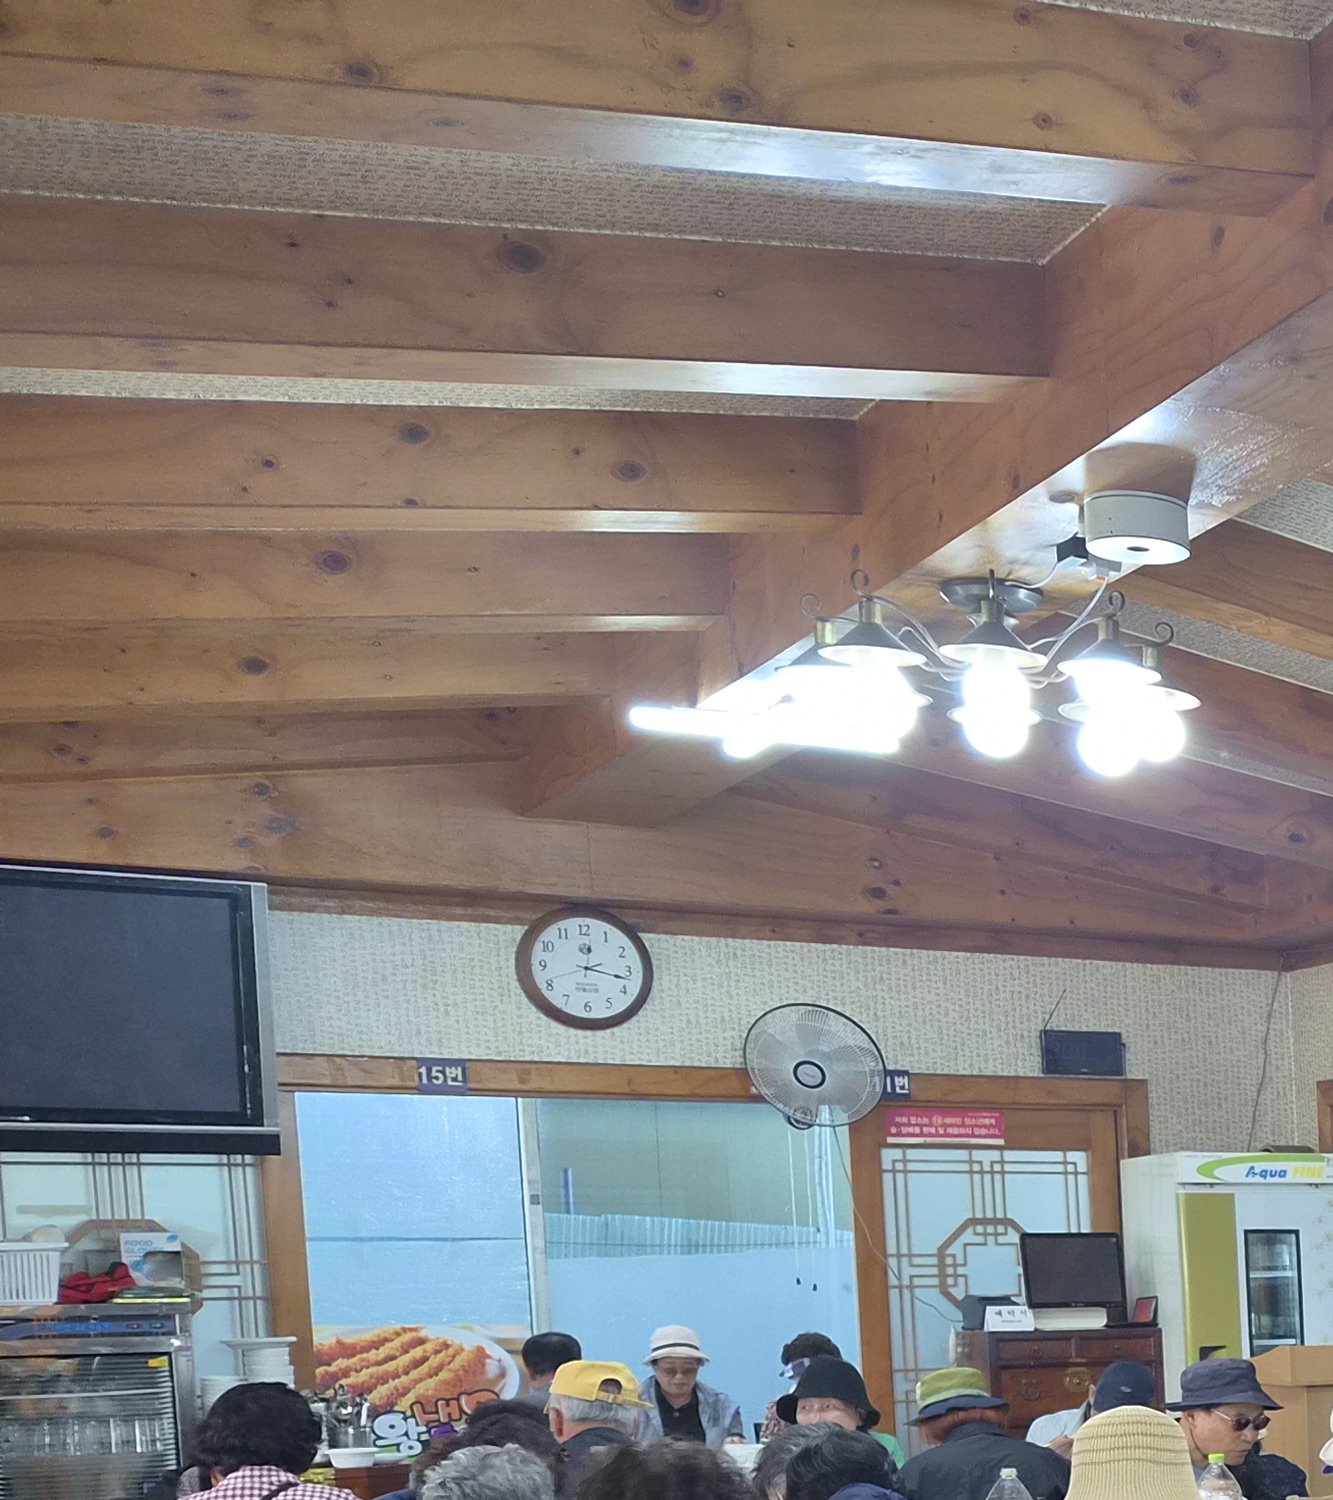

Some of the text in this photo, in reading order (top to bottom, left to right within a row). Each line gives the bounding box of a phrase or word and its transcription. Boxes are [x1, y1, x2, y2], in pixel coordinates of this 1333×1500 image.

[557, 928, 568, 940] 11
[578, 924, 591, 936] 12
[603, 930, 608, 943] 1
[542, 940, 554, 953] 10
[618, 946, 626, 958] 2
[538, 959, 547, 972] 9
[625, 965, 632, 977] 3
[545, 979, 554, 991] 8
[620, 984, 627, 995] 4
[562, 994, 570, 1006] 7
[605, 998, 613, 1009] 5
[584, 1001, 592, 1013] 6
[418, 1065, 463, 1086] 15번
[1245, 1165, 1288, 1181] Aqua
[1291, 1166, 1324, 1179] FINE
[371, 1410, 428, 1457] 왕
